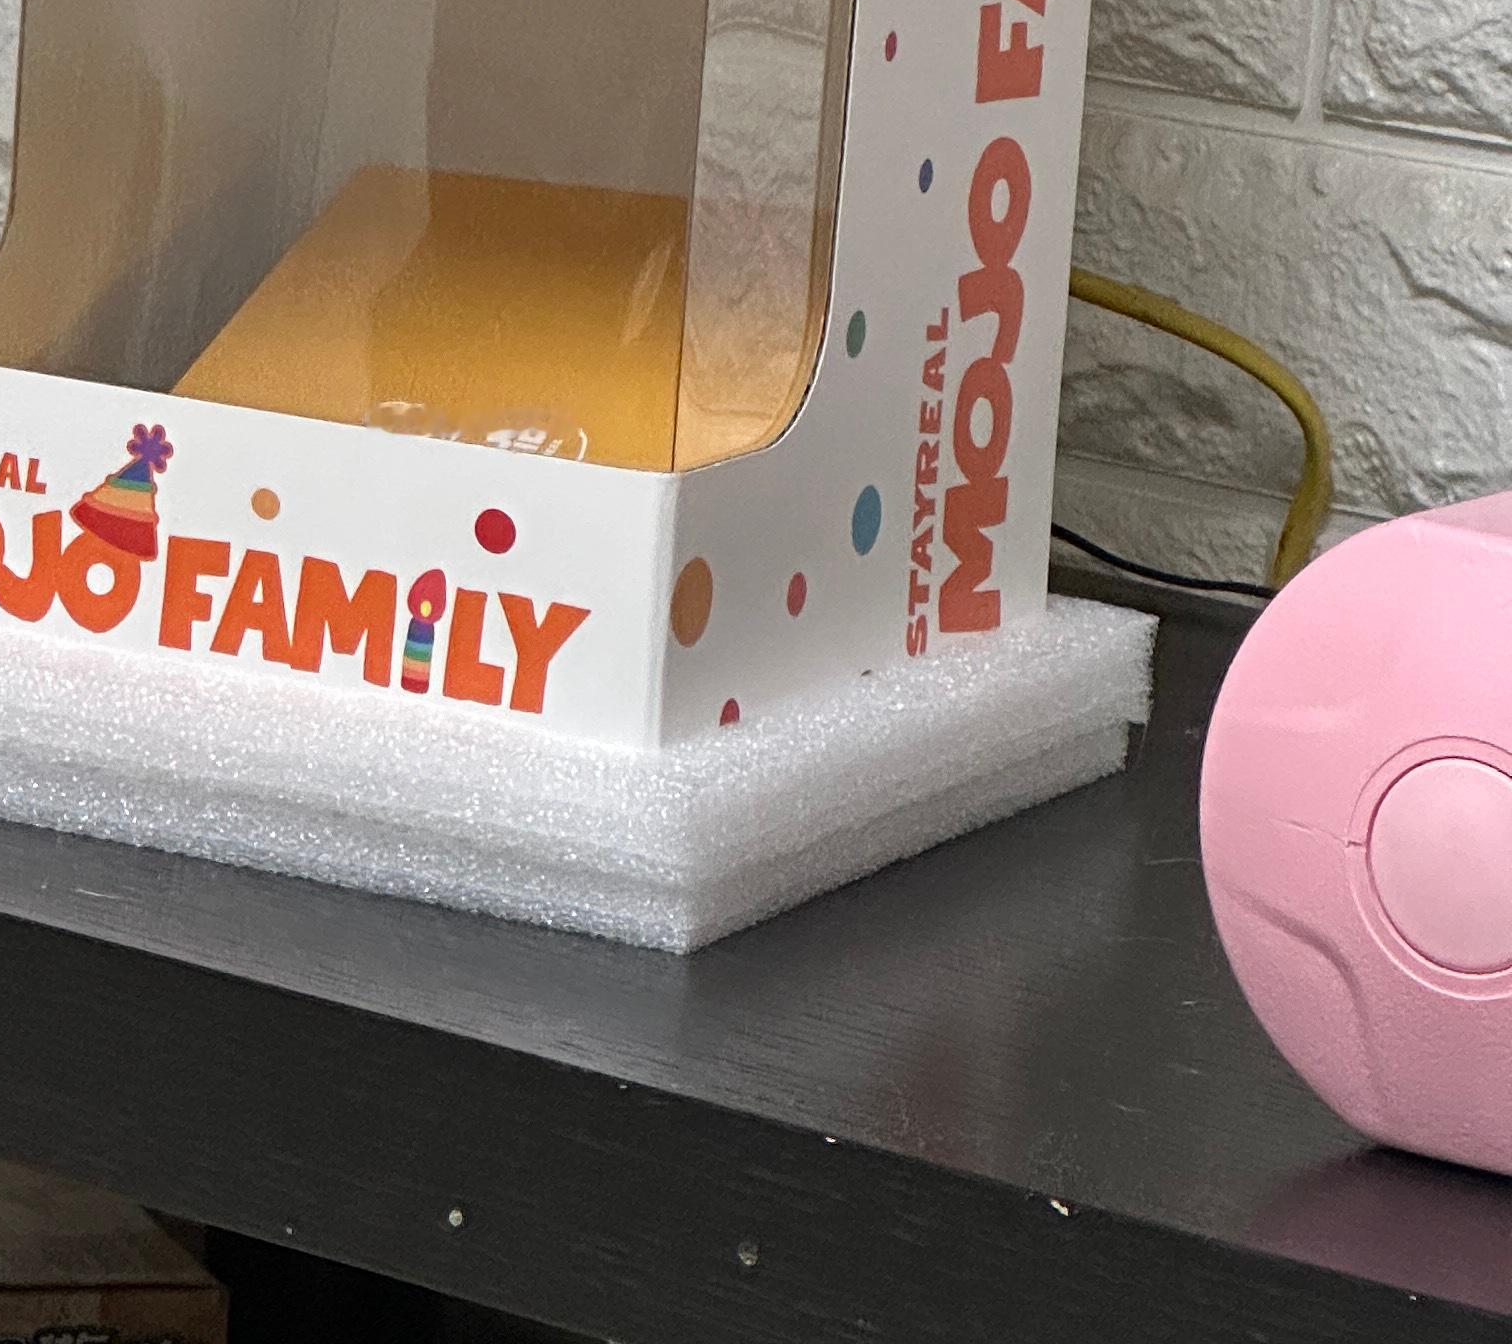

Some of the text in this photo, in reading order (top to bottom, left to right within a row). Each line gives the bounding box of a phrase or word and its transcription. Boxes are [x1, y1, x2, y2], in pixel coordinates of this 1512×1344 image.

[906, 307, 950, 657] STAYREAL
[937, 136, 1031, 633] MOJO
[158, 534, 591, 714] FAMILY
